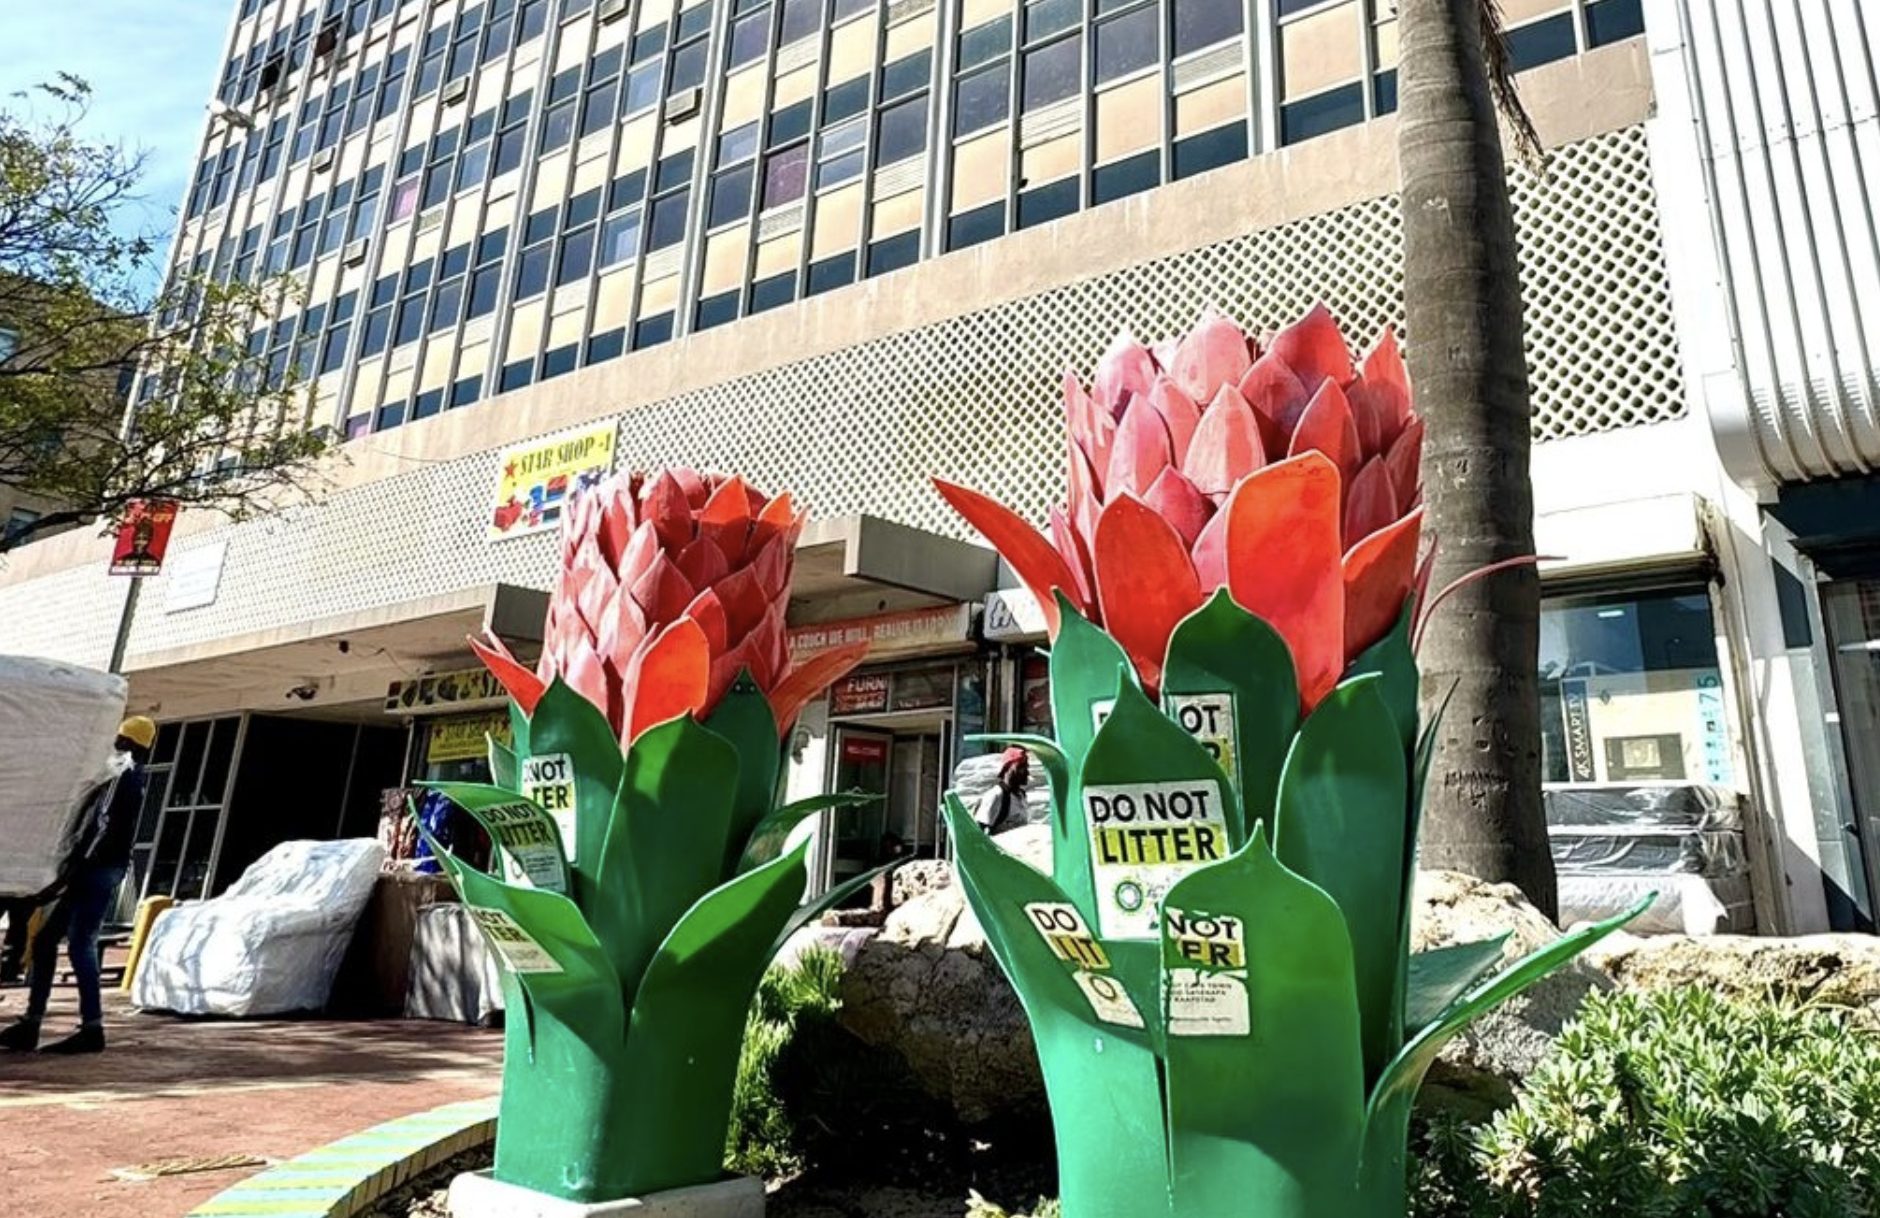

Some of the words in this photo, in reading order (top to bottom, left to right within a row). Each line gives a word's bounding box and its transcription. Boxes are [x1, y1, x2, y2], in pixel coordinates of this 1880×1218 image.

[521, 447, 554, 475] STAR
[557, 436, 595, 463] SHOP
[798, 632, 826, 648] COUCH
[1571, 711, 1589, 759] SMART
[529, 760, 566, 782] NOT
[1575, 760, 1590, 779] 4K
[481, 807, 506, 823] DO
[505, 803, 536, 820] NOT
[1089, 793, 1136, 823] DO
[1143, 790, 1209, 820] NOT
[1100, 827, 1218, 863] LITTER
[1032, 908, 1078, 931] DO
[1167, 912, 1236, 939] NOT
